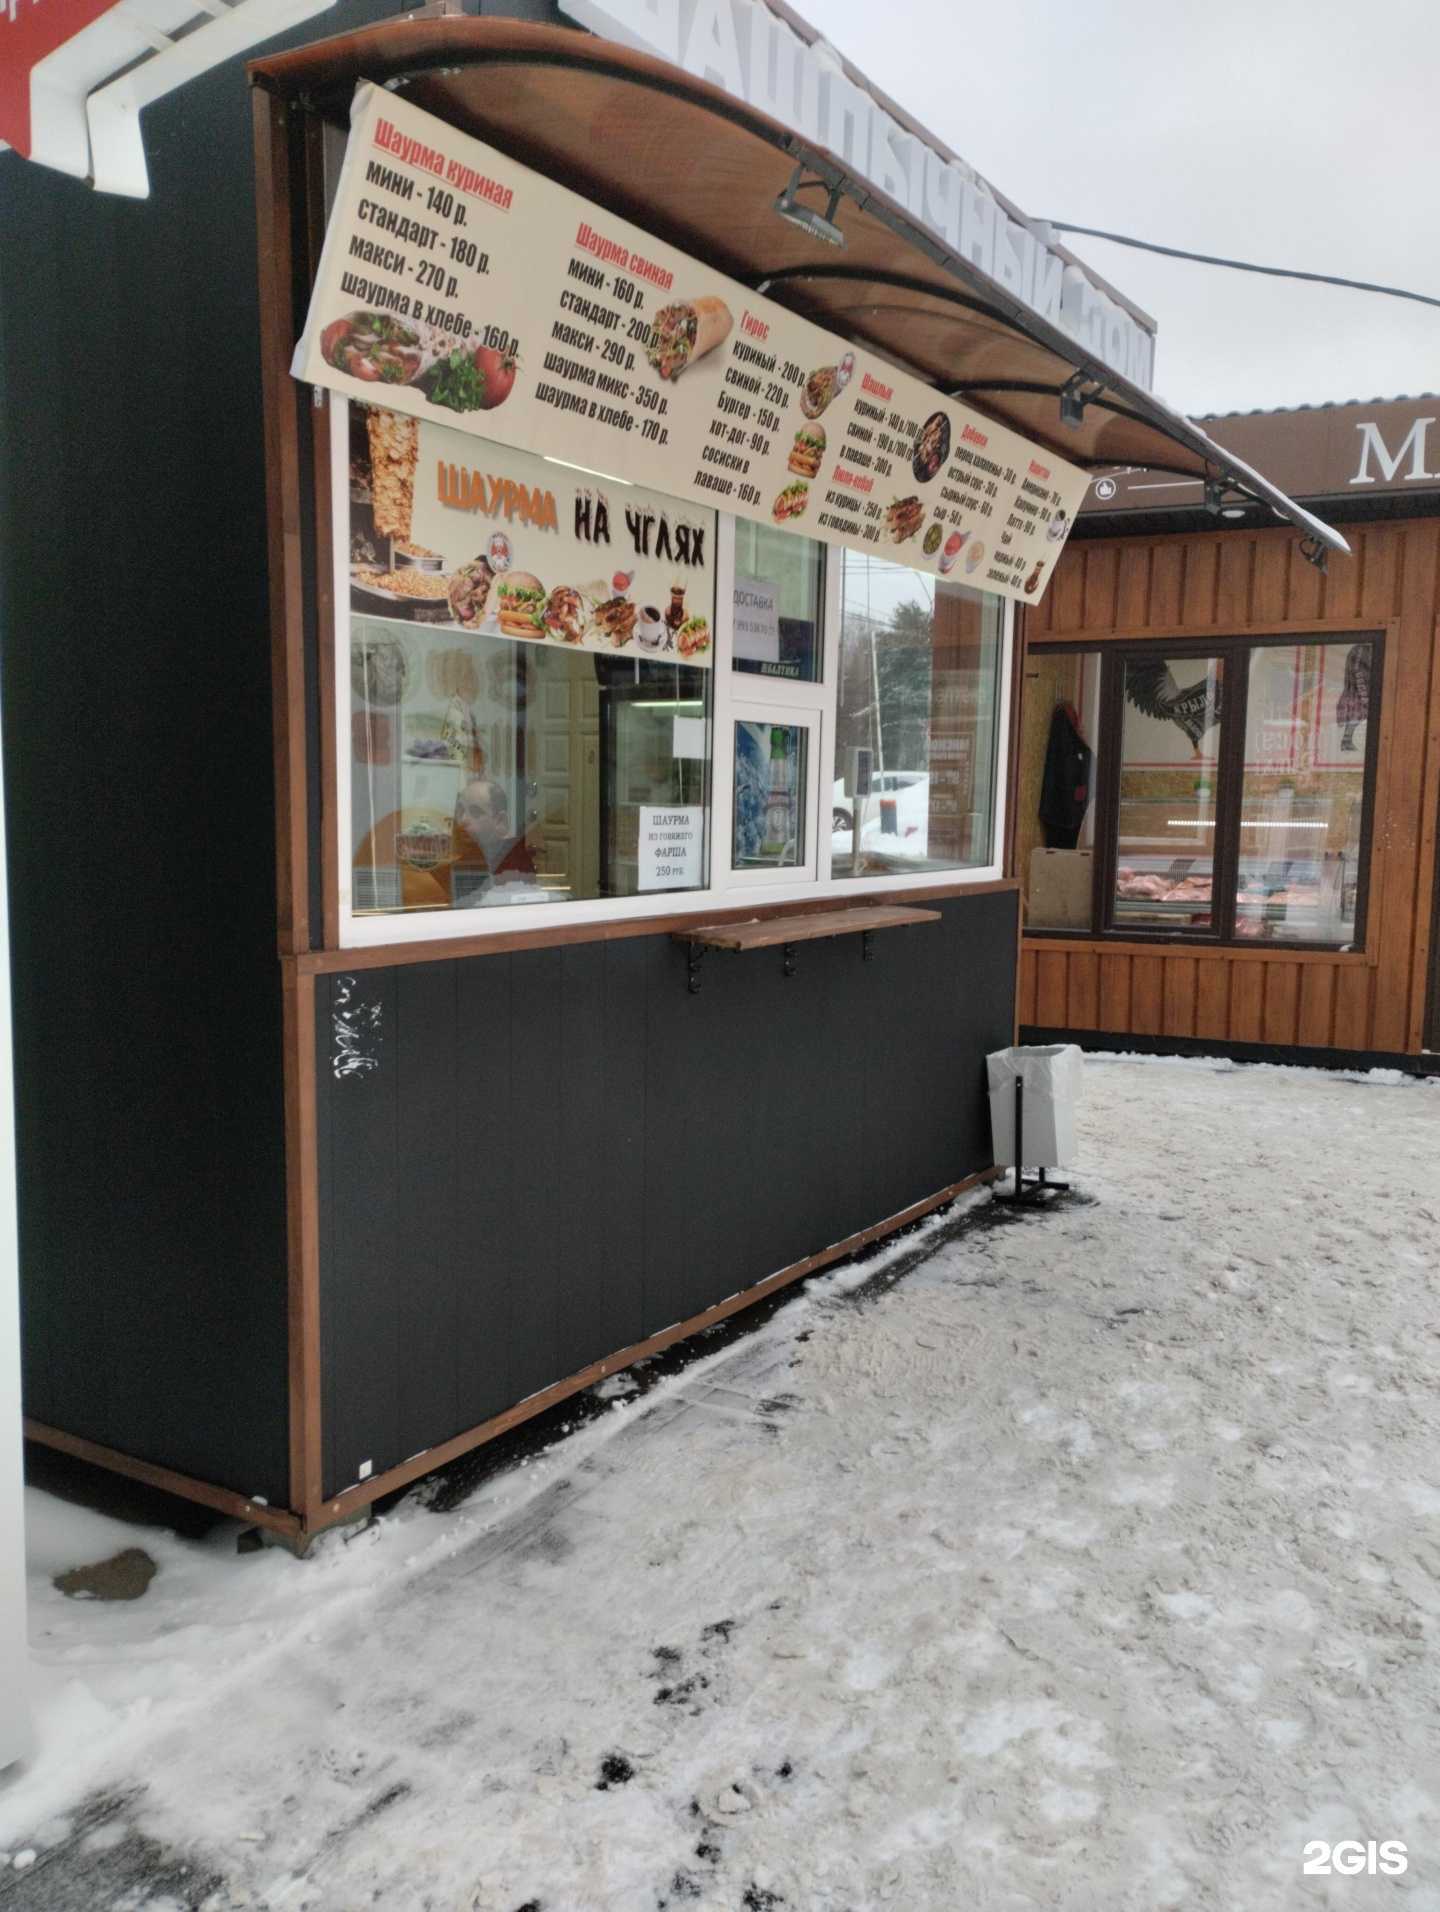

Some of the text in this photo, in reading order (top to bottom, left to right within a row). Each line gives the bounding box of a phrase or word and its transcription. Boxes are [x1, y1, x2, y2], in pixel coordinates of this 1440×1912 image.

[374, 118, 513, 209] Шаурма куриная
[366, 161, 414, 200] мини
[427, 186, 454, 218] 140
[453, 203, 467, 227] р.
[358, 199, 439, 250] стандарт
[450, 236, 477, 267] 180
[477, 252, 489, 275] р.
[576, 223, 673, 289] Шаурма свиная
[349, 235, 406, 275] макси
[415, 260, 445, 291] 270
[445, 276, 458, 298] р.
[568, 258, 605, 290] мини
[613, 277, 635, 304] 160
[633, 290, 644, 310] р.
[341, 272, 410, 316] шаурма
[412, 300, 423, 320] в
[424, 305, 472, 339] хлебе
[480, 325, 509, 355] 160
[505, 338, 519, 359] р.
[560, 290, 621, 330] стандарт
[626, 317, 654, 347] 200
[741, 310, 770, 340] Гирос
[552, 321, 595, 353] макси
[601, 339, 626, 366] 290
[624, 352, 635, 371] р.
[732, 340, 776, 373] куриный
[781, 361, 800, 384] 200
[543, 352, 596, 386] шаурма
[596, 373, 629, 399] микс
[635, 385, 659, 410] 350
[658, 398, 668, 415] р.
[725, 367, 761, 395] свиной
[764, 382, 783, 405] 220
[780, 392, 789, 408] р.
[535, 382, 588, 415] шаурма
[588, 402, 597, 418] в
[597, 405, 634, 431] хлебе
[641, 419, 660, 440] 170
[658, 428, 668, 445] р.
[709, 419, 747, 445] хот-дог
[750, 433, 764, 452] 90
[761, 440, 770, 456] р.
[757, 408, 774, 429] 150
[771, 417, 780, 432] р.
[702, 445, 750, 474] сосиски в
[438, 461, 559, 531] ШАУРМА
[574, 493, 611, 545] НА
[694, 471, 733, 495] лаваше
[738, 483, 755, 502] 160
[752, 491, 761, 505] р.
[652, 815, 690, 826] ШАУРМА
[654, 847, 687, 858] ФАРША
[656, 865, 671, 877] 250
